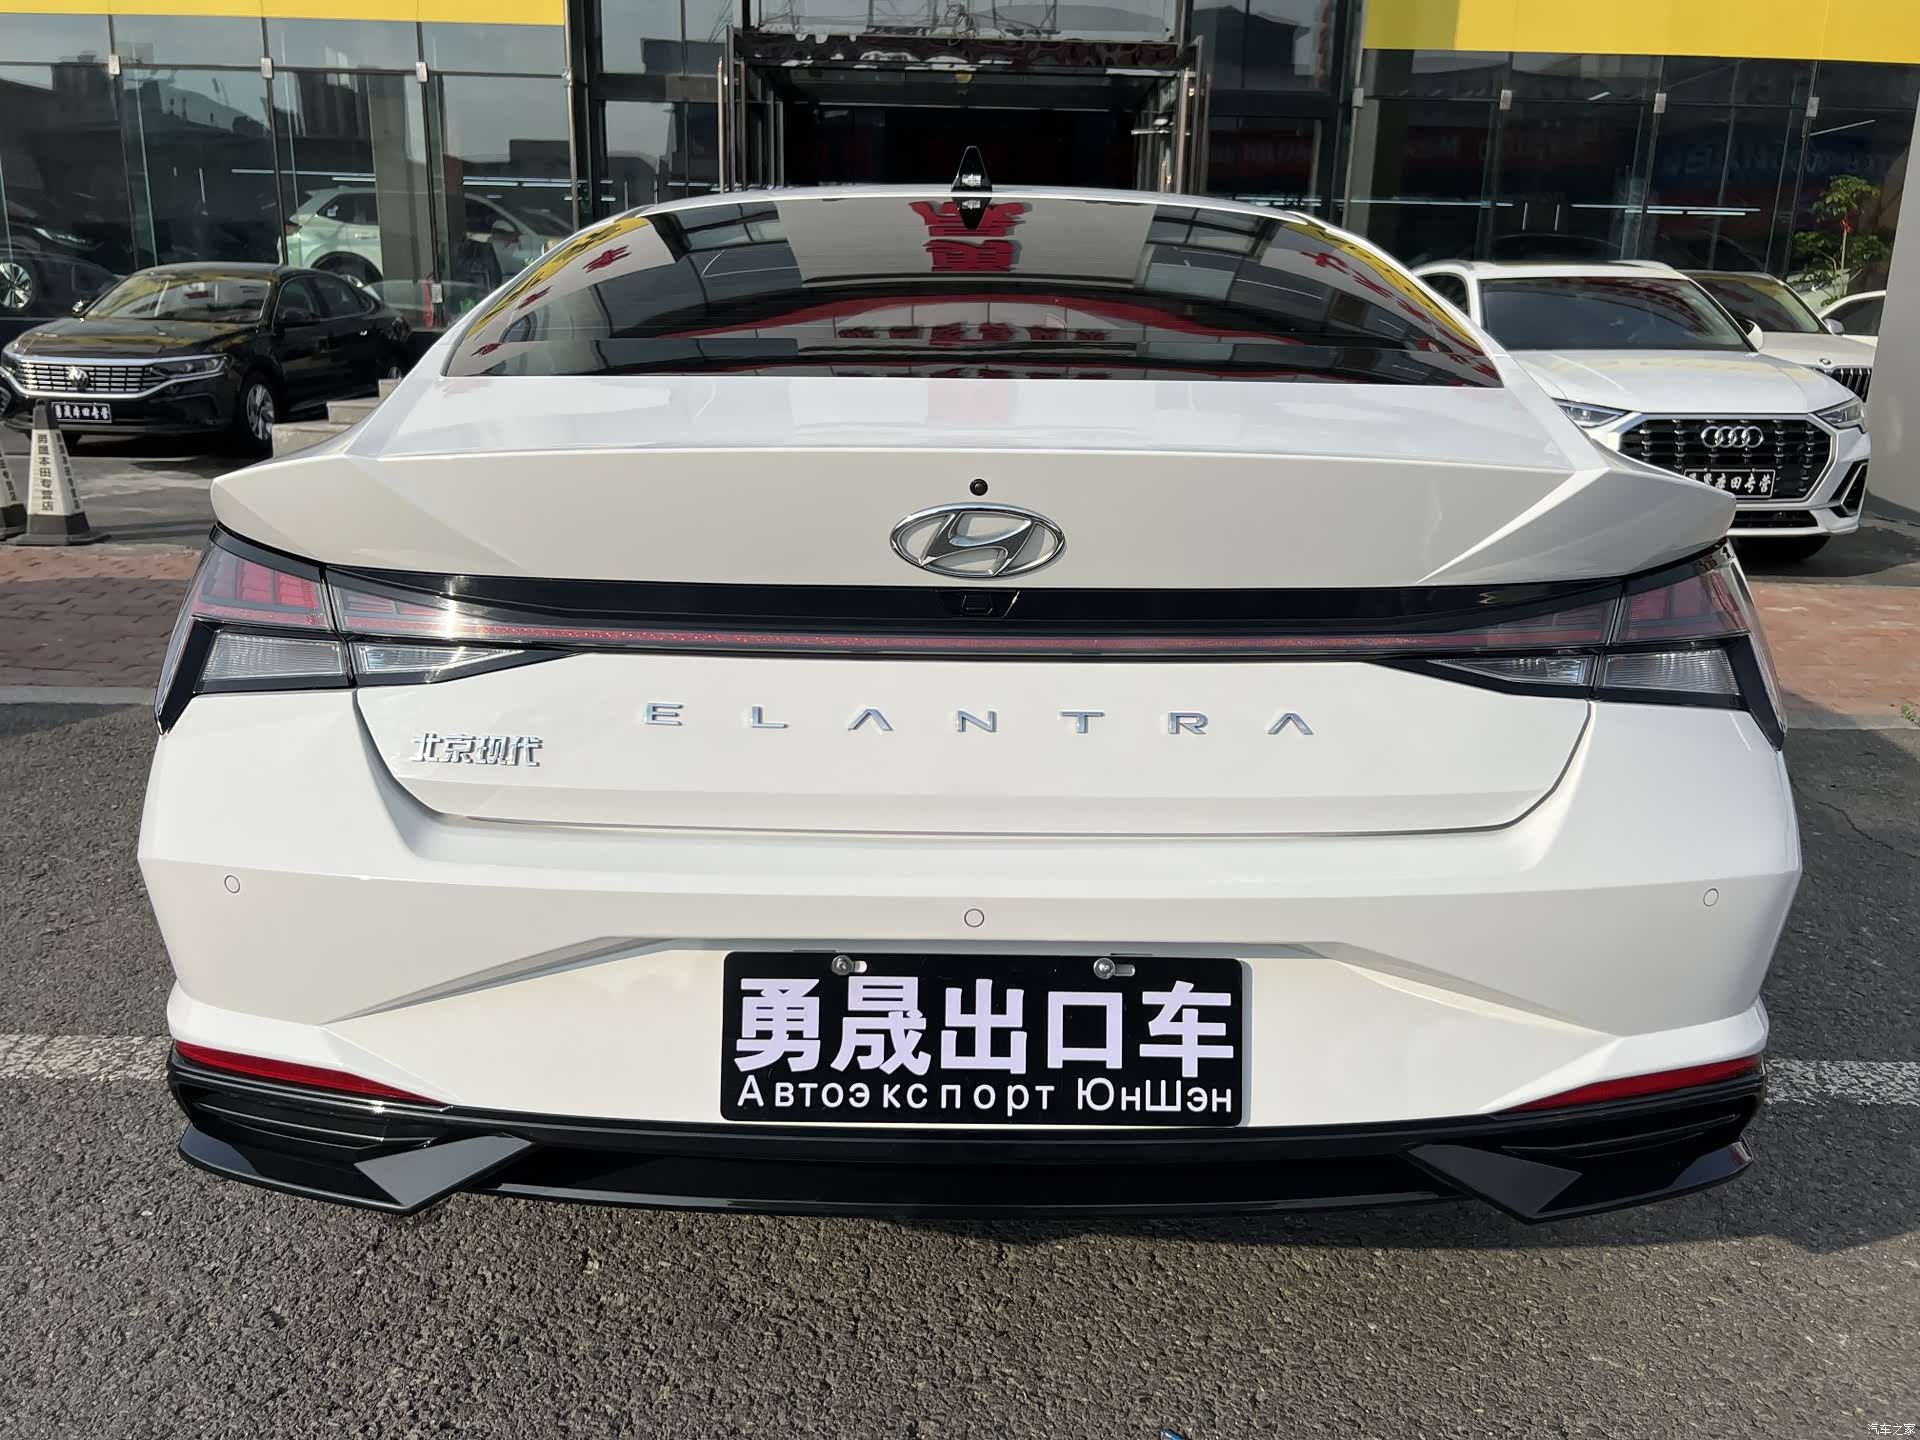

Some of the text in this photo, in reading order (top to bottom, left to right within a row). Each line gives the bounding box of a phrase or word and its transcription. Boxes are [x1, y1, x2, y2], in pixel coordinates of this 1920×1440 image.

[644, 701, 1314, 736] ELANTRA
[411, 732, 544, 767] 北京现代
[734, 975, 1235, 1078] 勇晟出口车
[1077, 1076, 1233, 1113] ЮнШэн
